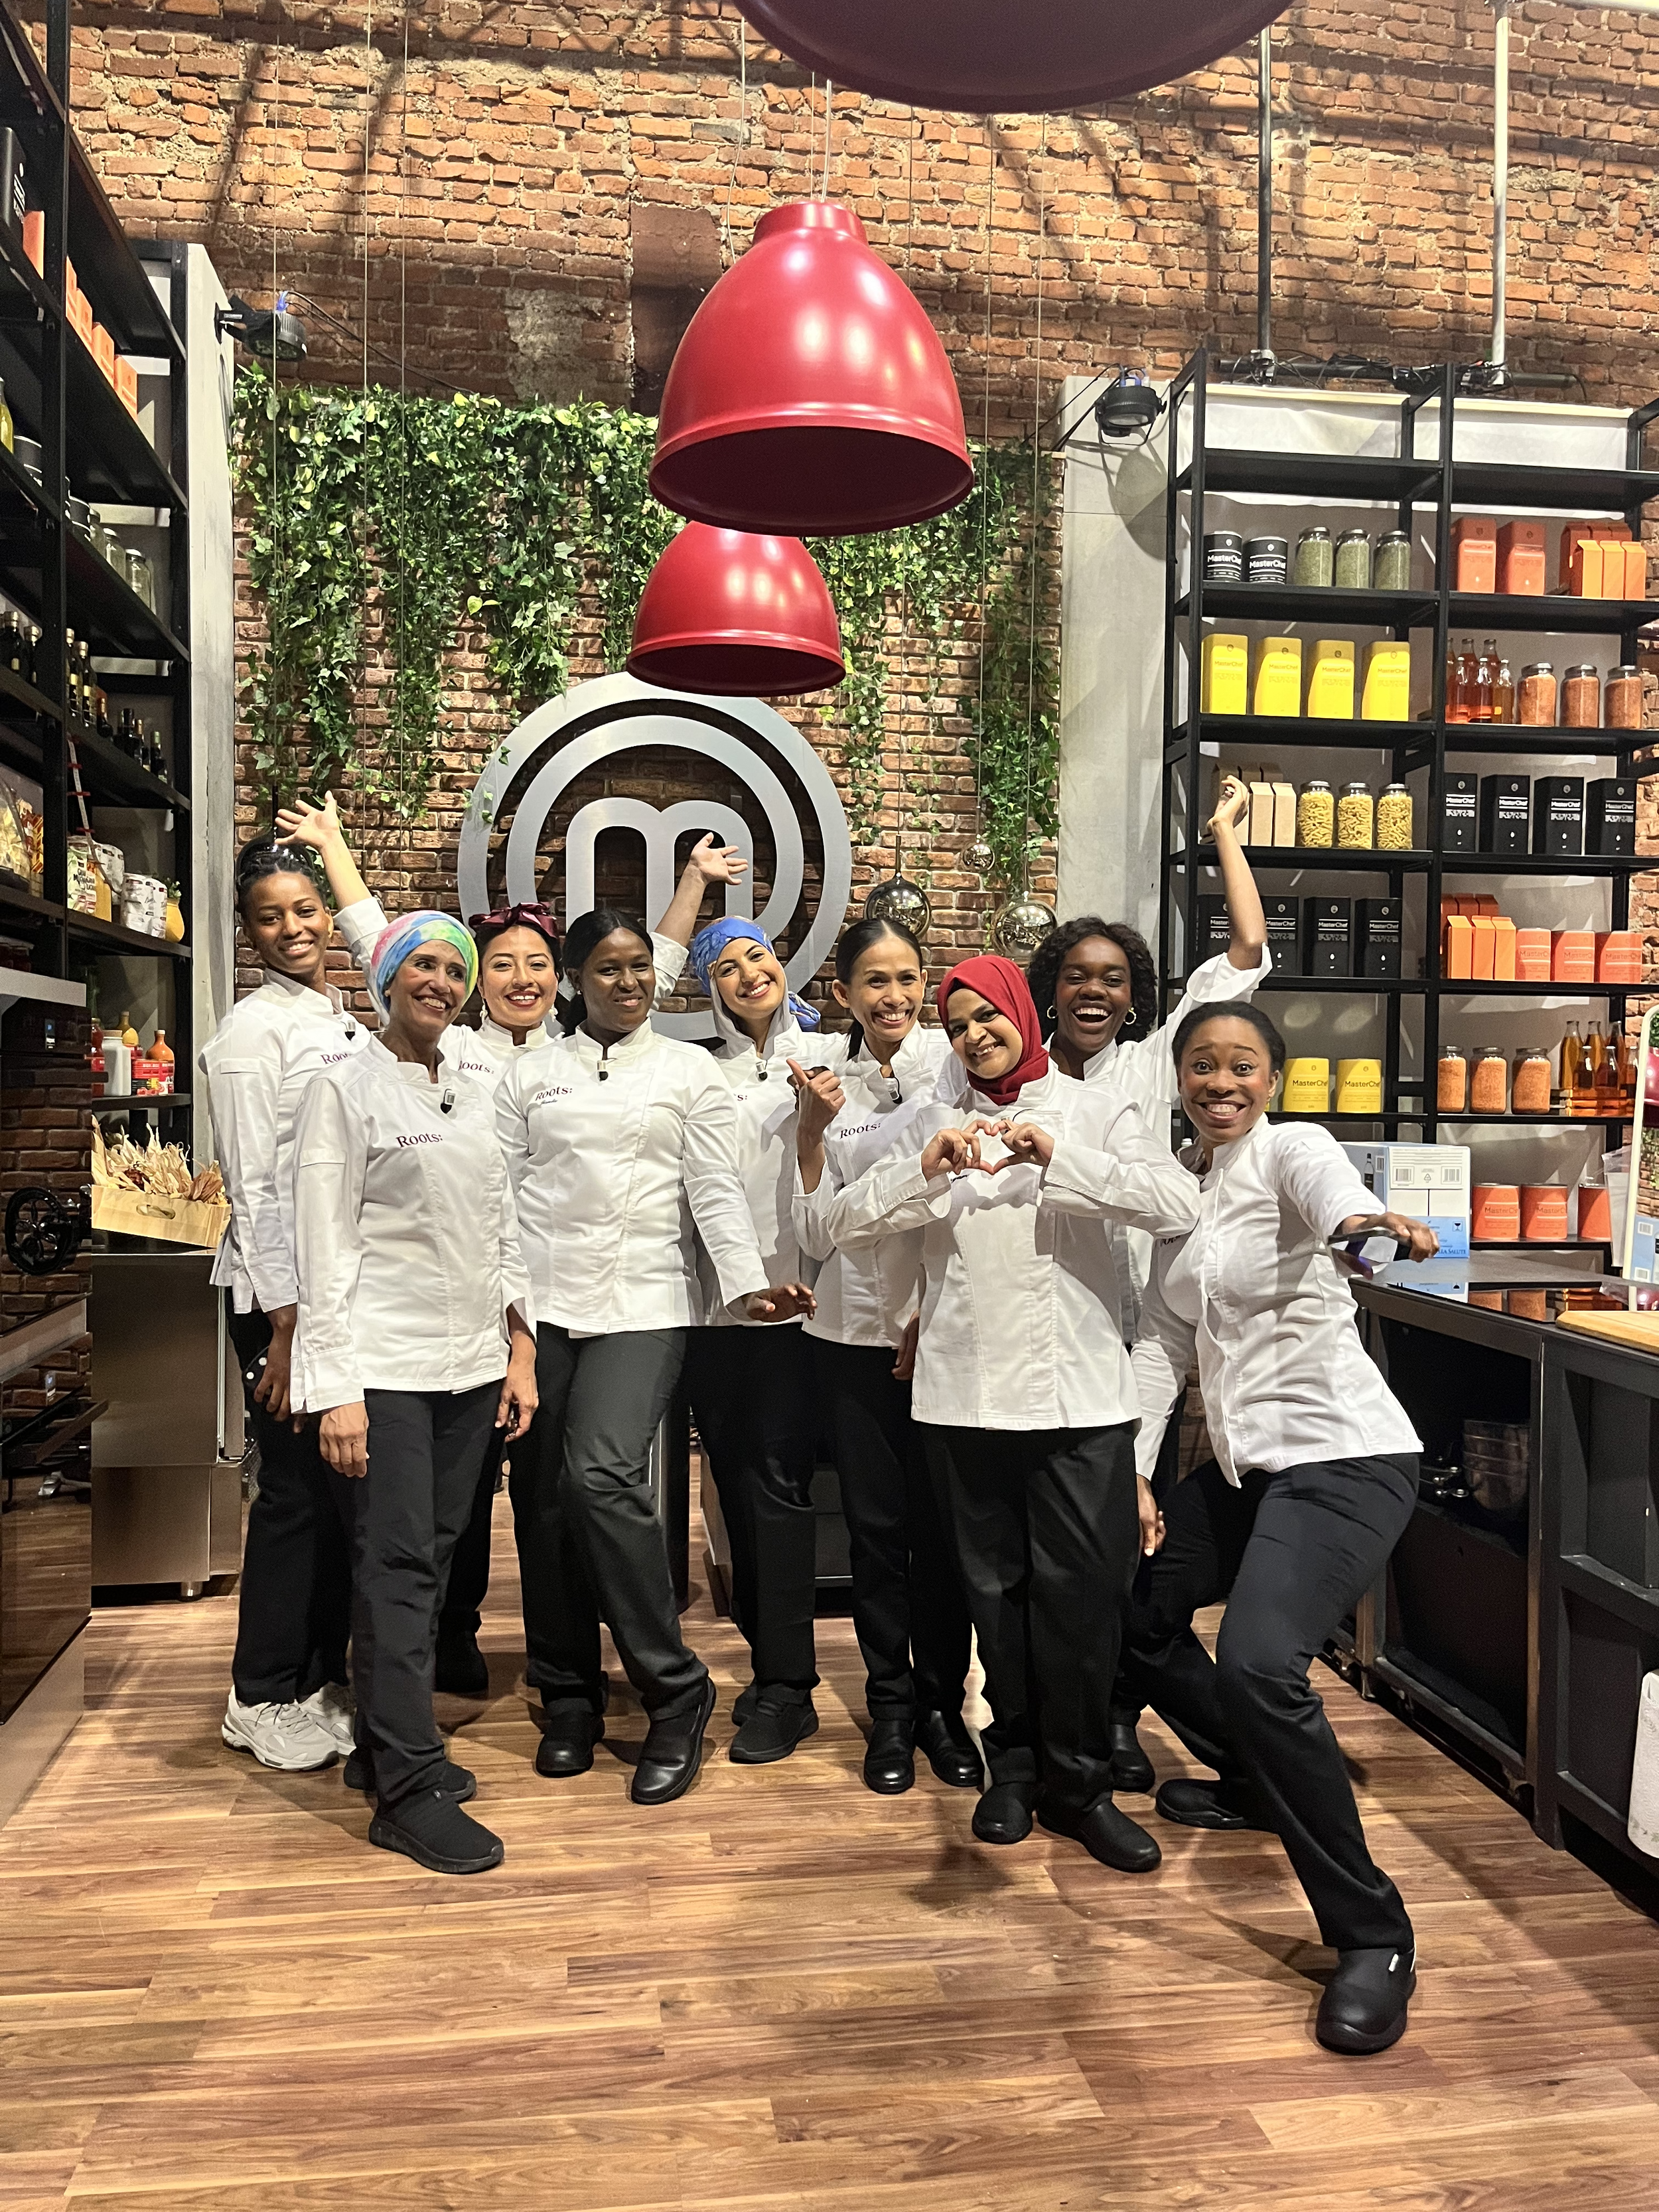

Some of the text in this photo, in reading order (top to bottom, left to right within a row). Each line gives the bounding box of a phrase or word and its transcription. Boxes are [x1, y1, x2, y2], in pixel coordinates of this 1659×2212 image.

[535, 1086, 573, 1101] Roots:
[839, 1123, 881, 1140] Roots:
[396, 1133, 443, 1147] Roots:
